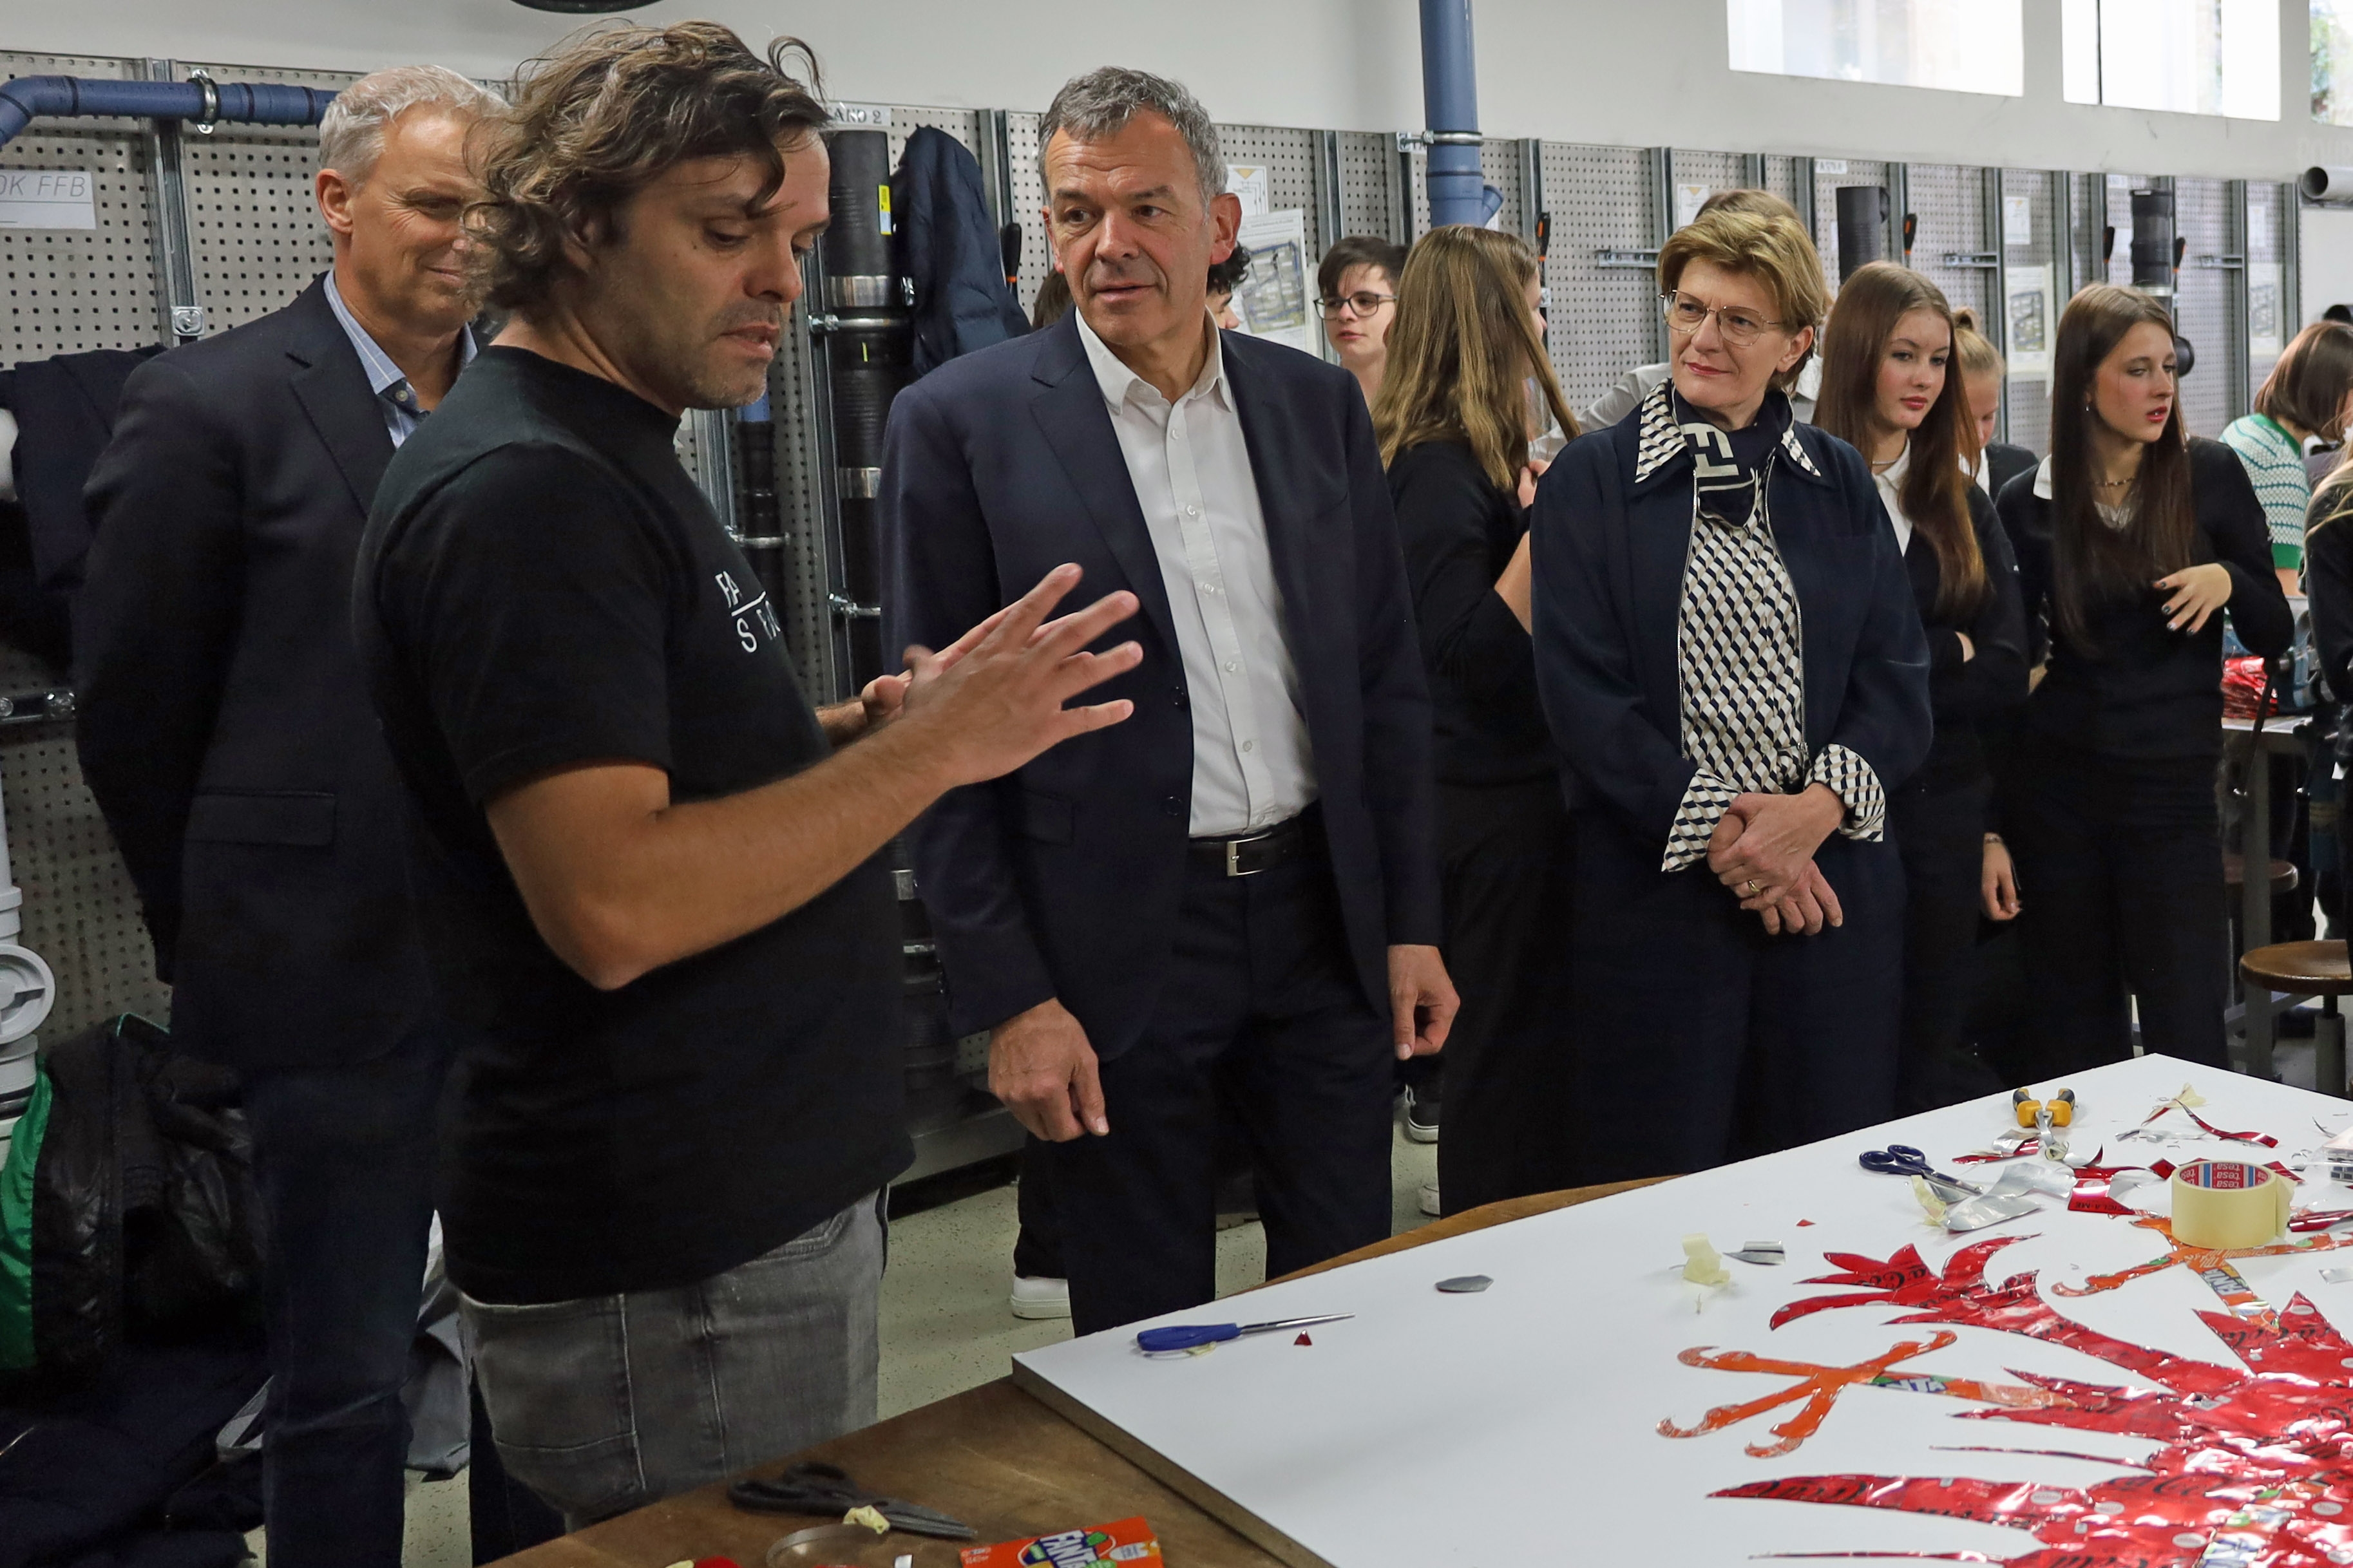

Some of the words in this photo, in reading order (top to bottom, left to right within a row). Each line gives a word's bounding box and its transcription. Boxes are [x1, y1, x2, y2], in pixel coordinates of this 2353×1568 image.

[873, 109, 882, 124] 2
[37, 175, 86, 197] FFB
[2216, 1163, 2241, 1171] tesa
[2216, 1171, 2241, 1180] tesa
